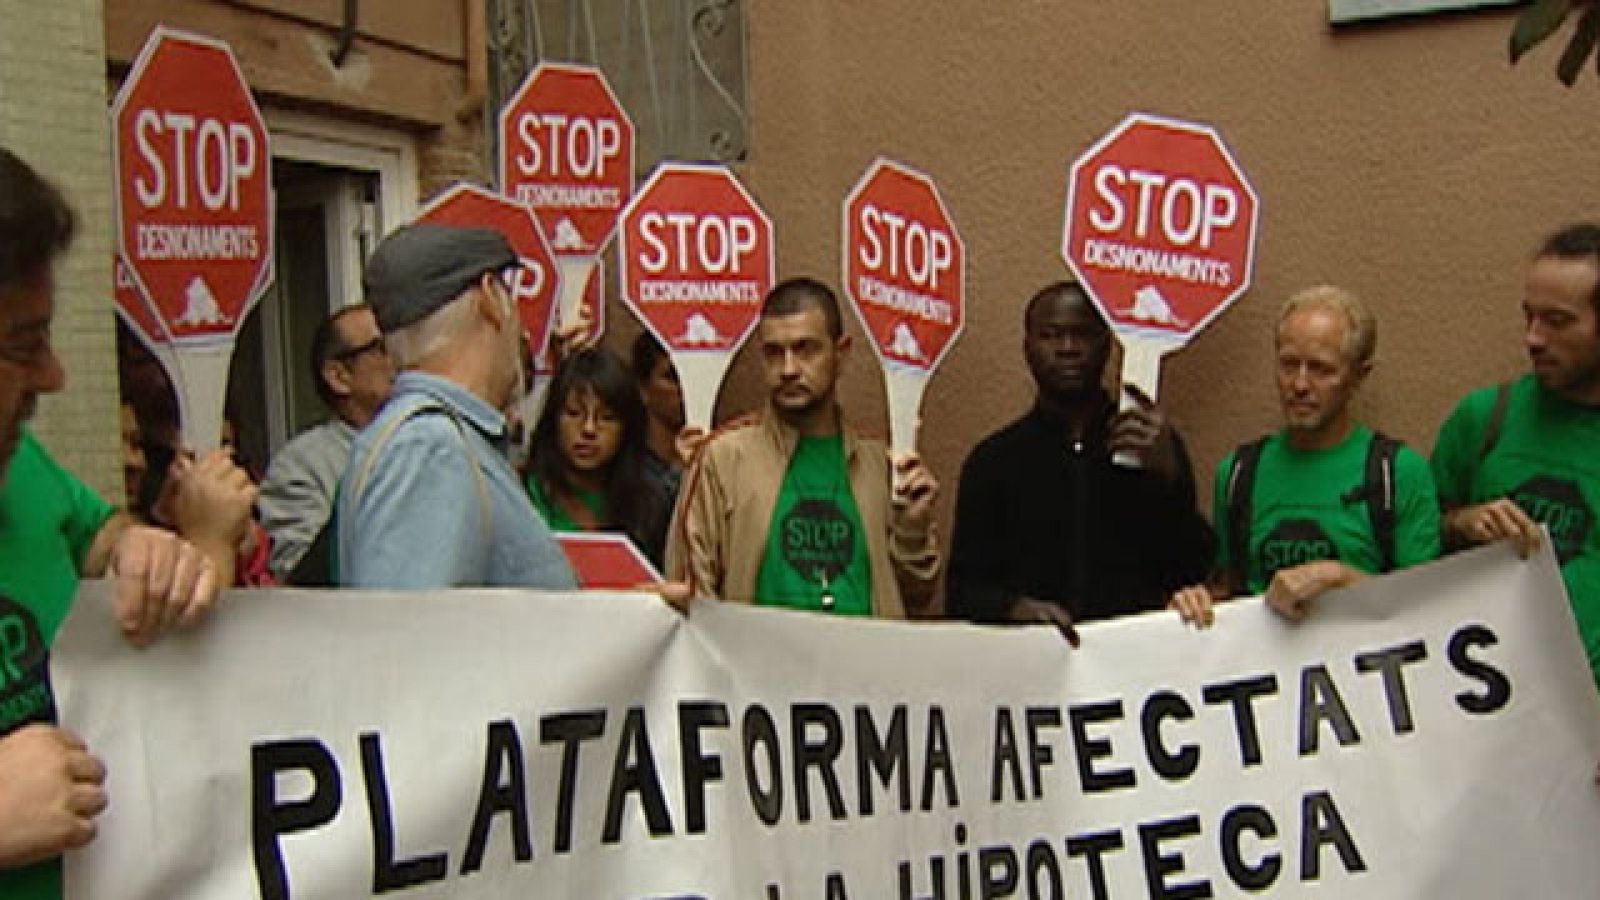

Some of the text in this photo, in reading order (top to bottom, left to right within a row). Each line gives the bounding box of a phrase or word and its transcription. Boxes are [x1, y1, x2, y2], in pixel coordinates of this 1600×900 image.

[134, 110, 256, 211] STOP
[518, 112, 620, 178] STOP
[1089, 164, 1238, 249] STOP
[136, 224, 259, 261] DESNONAMENTS
[639, 211, 757, 274] STOP
[859, 205, 952, 290] STOP
[1084, 239, 1232, 287] DESNONAMENTS
[639, 279, 760, 304] DESNONAMENTS
[250, 624, 1513, 900] PLATAFORMA AFECTATS
